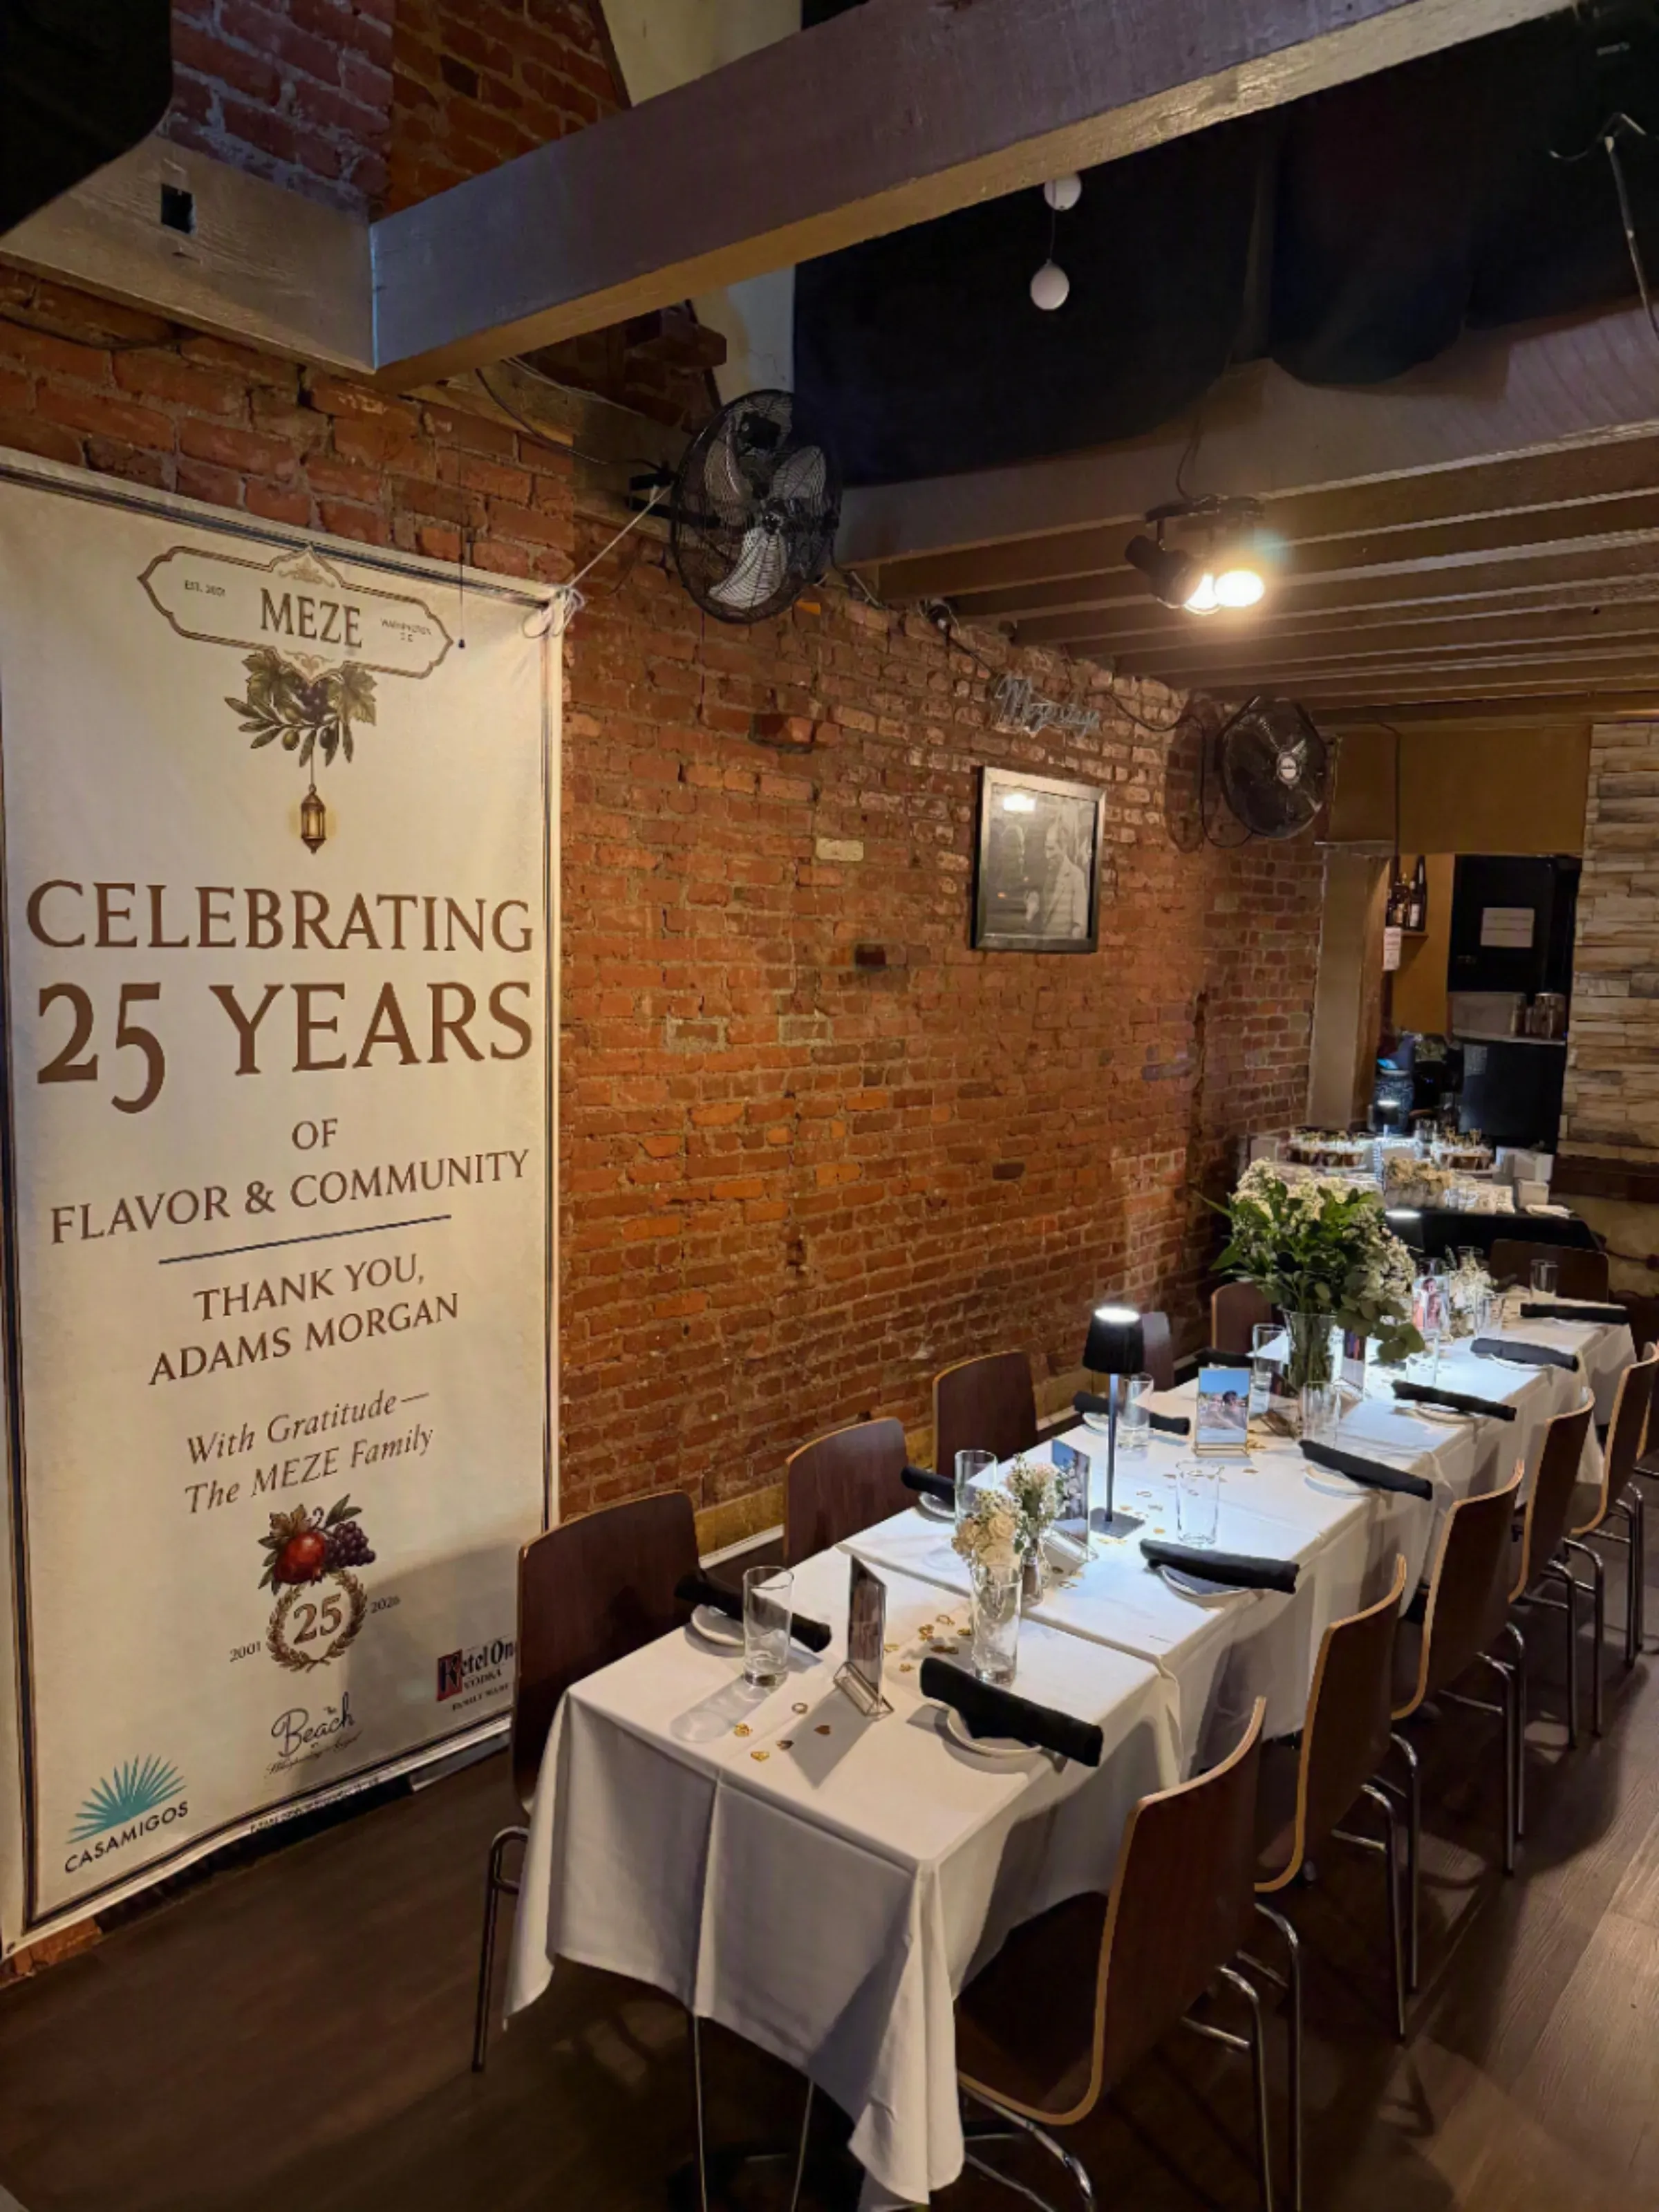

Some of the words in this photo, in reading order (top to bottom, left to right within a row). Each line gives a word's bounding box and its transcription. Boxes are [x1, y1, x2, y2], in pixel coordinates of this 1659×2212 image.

[259, 588, 363, 648] MEZE
[26, 879, 533, 953] CELEBRATING
[37, 982, 165, 1114] 25
[209, 982, 532, 1076] YEARS
[291, 1118, 338, 1150] OF
[51, 1185, 230, 1244] FLAVOR
[244, 1180, 275, 1215] &
[290, 1148, 529, 1208] COMMUNITY
[194, 1268, 334, 1321] THANK
[345, 1253, 424, 1291] YOU,
[149, 1327, 291, 1385] ADAMS
[305, 1293, 458, 1351] MORGAN
[185, 1481, 240, 1513] The
[250, 1446, 339, 1497] MEZE
[350, 1424, 433, 1468] Family
[187, 1422, 255, 1465] With
[229, 1641, 261, 1662] 2001
[293, 1592, 342, 1644] 25
[440, 1645, 488, 1693] Ketel
[491, 1640, 514, 1664] On
[271, 1691, 355, 1757] Beach
[64, 1801, 188, 1873] CASAMIGOS
